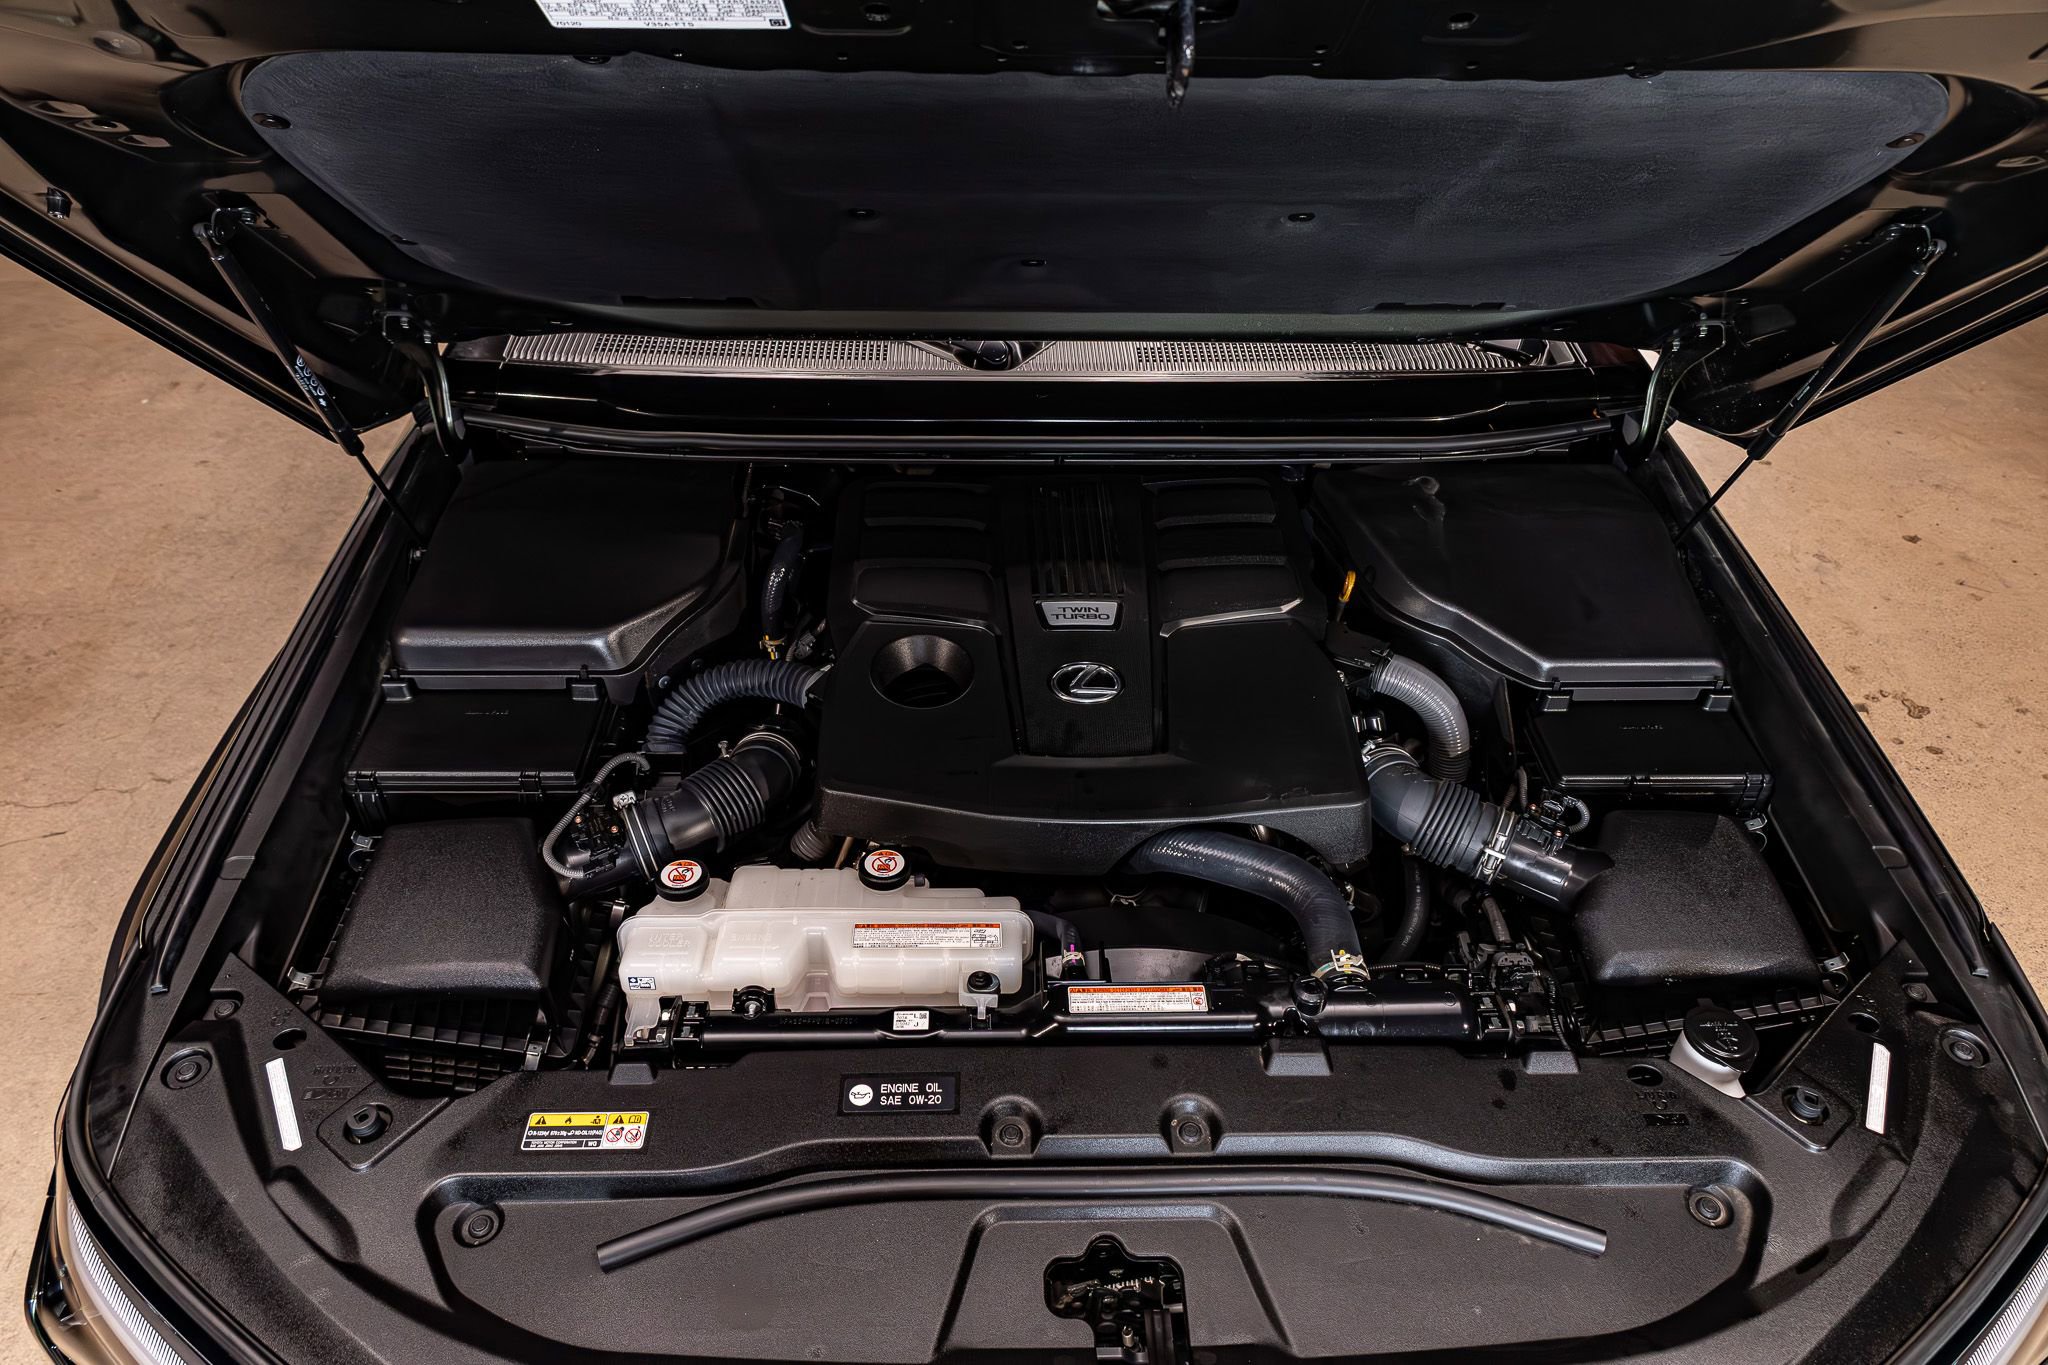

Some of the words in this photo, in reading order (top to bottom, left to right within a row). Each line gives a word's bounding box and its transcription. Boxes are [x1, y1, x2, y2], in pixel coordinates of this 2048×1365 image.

[880, 1083, 919, 1093] ENGINE
[925, 1082, 943, 1092] OIL
[880, 1095, 902, 1106] SAE
[908, 1094, 942, 1105] 0W-20
